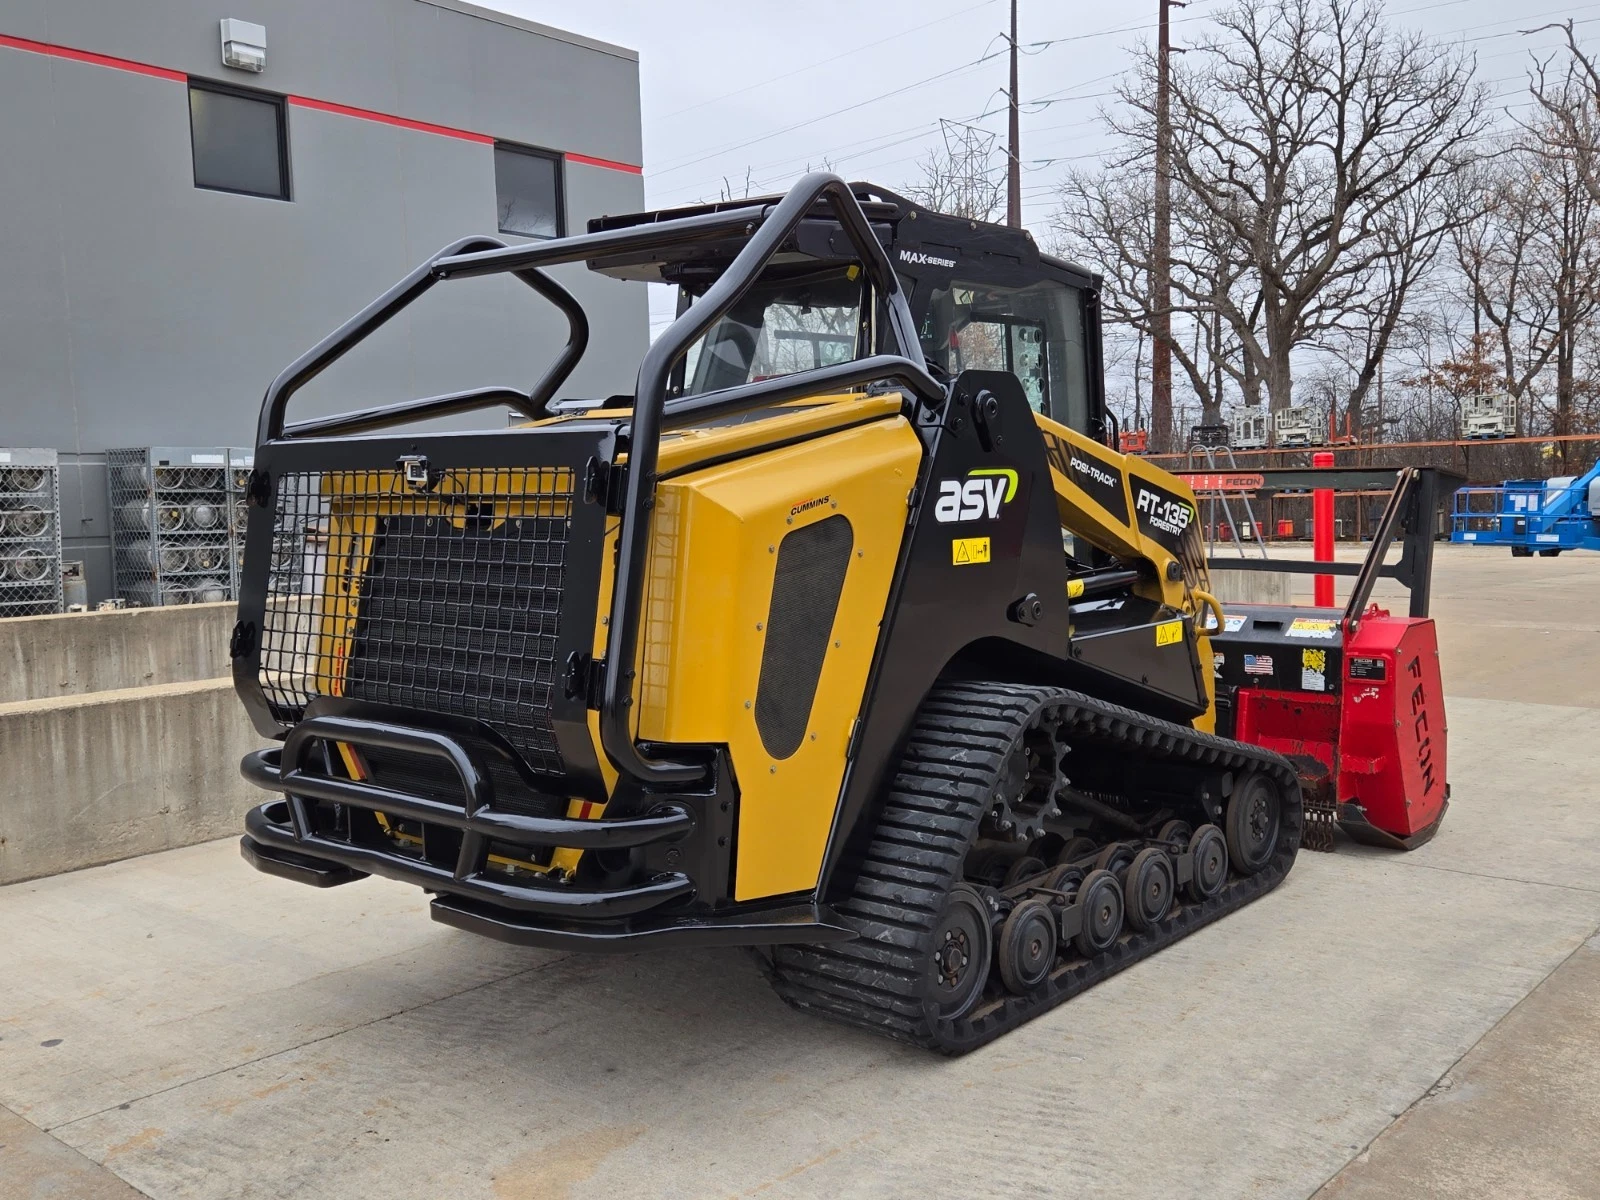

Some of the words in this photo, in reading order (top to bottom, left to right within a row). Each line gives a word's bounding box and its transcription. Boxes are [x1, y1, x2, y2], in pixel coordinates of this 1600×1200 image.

[1070, 457, 1114, 487] POSI-TRACK
[1226, 478, 1261, 486] FECON
[791, 495, 830, 515] CUMMINS
[1137, 489, 1190, 529] RT-135
[1150, 515, 1183, 536] FORESTRY
[1407, 655, 1435, 796] FECON
